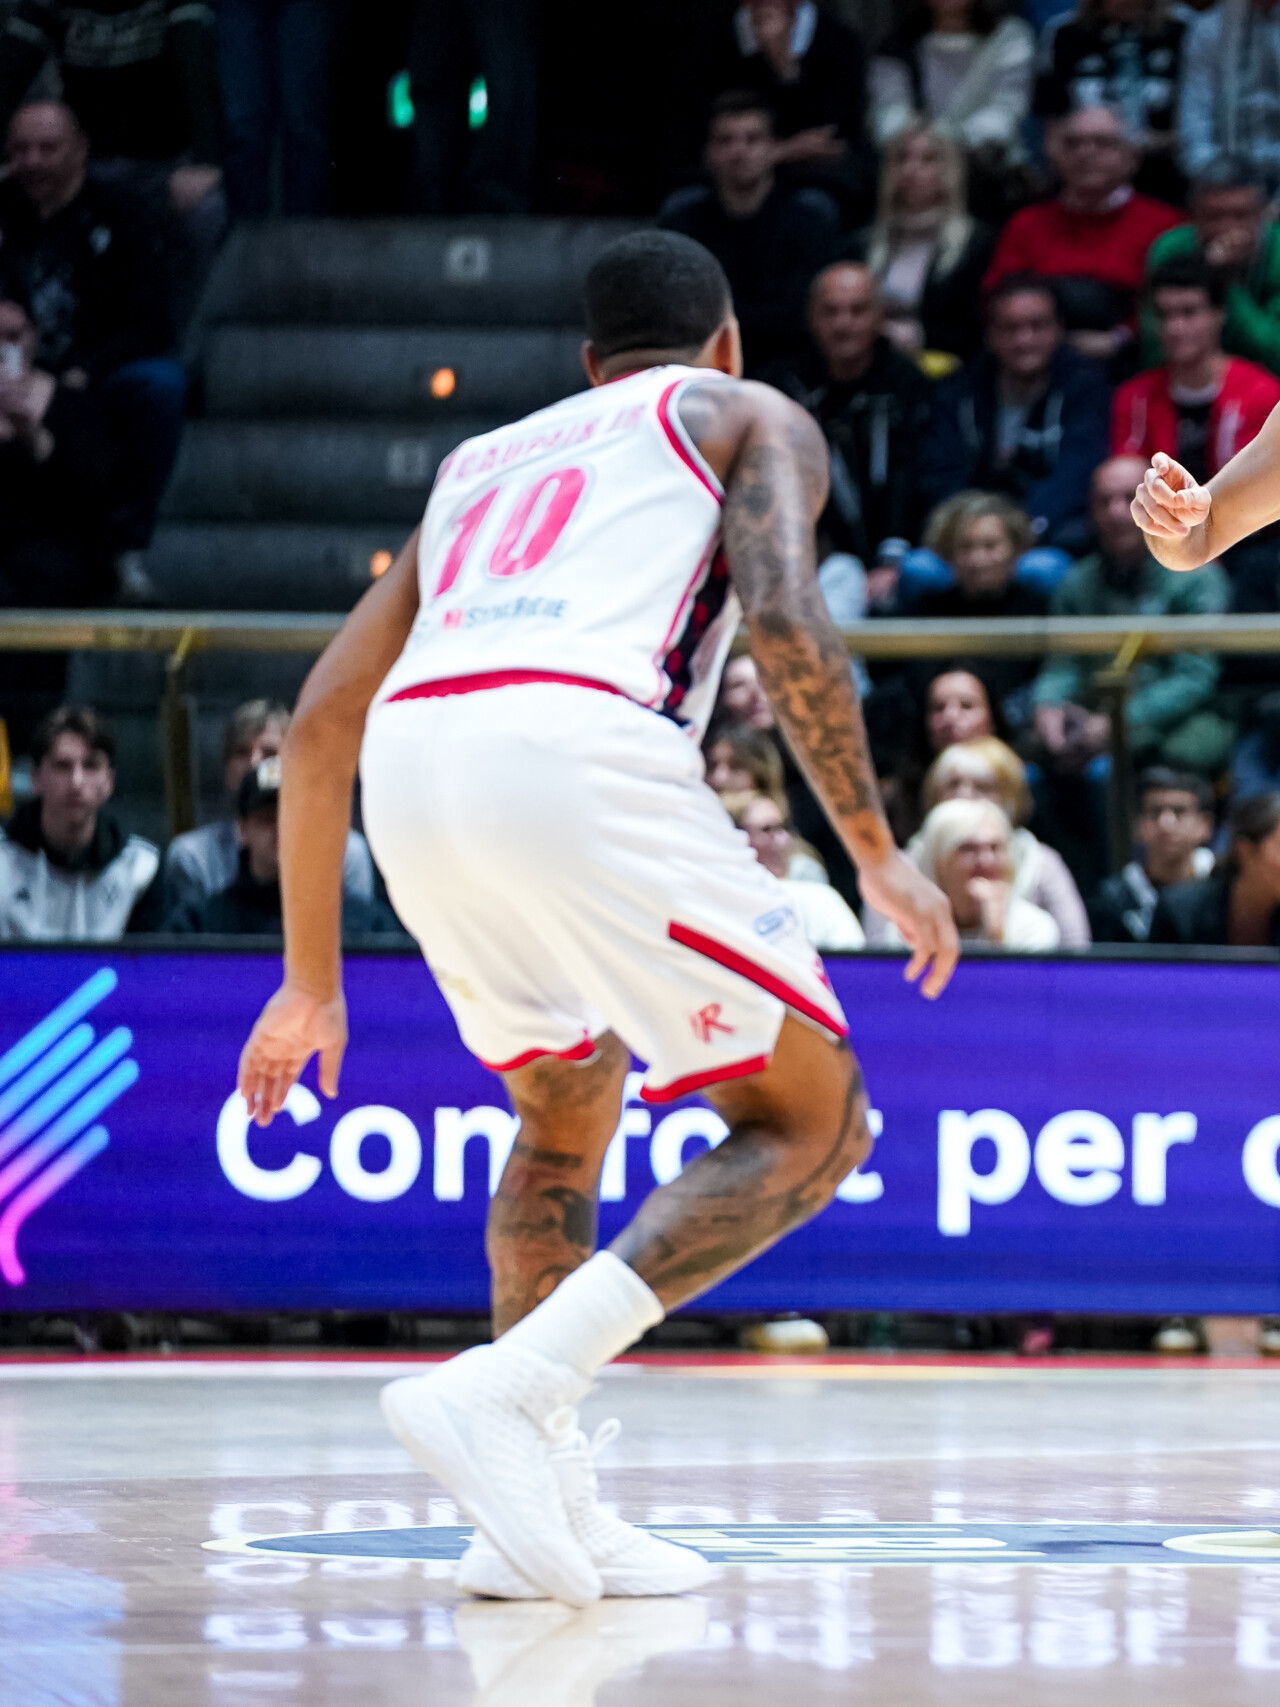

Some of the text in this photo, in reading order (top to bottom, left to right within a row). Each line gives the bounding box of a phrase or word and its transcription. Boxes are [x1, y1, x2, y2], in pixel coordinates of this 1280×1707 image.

[432, 467, 588, 600] 10
[216, 1071, 885, 1203] Comfo
[937, 1108, 1199, 1238] per
